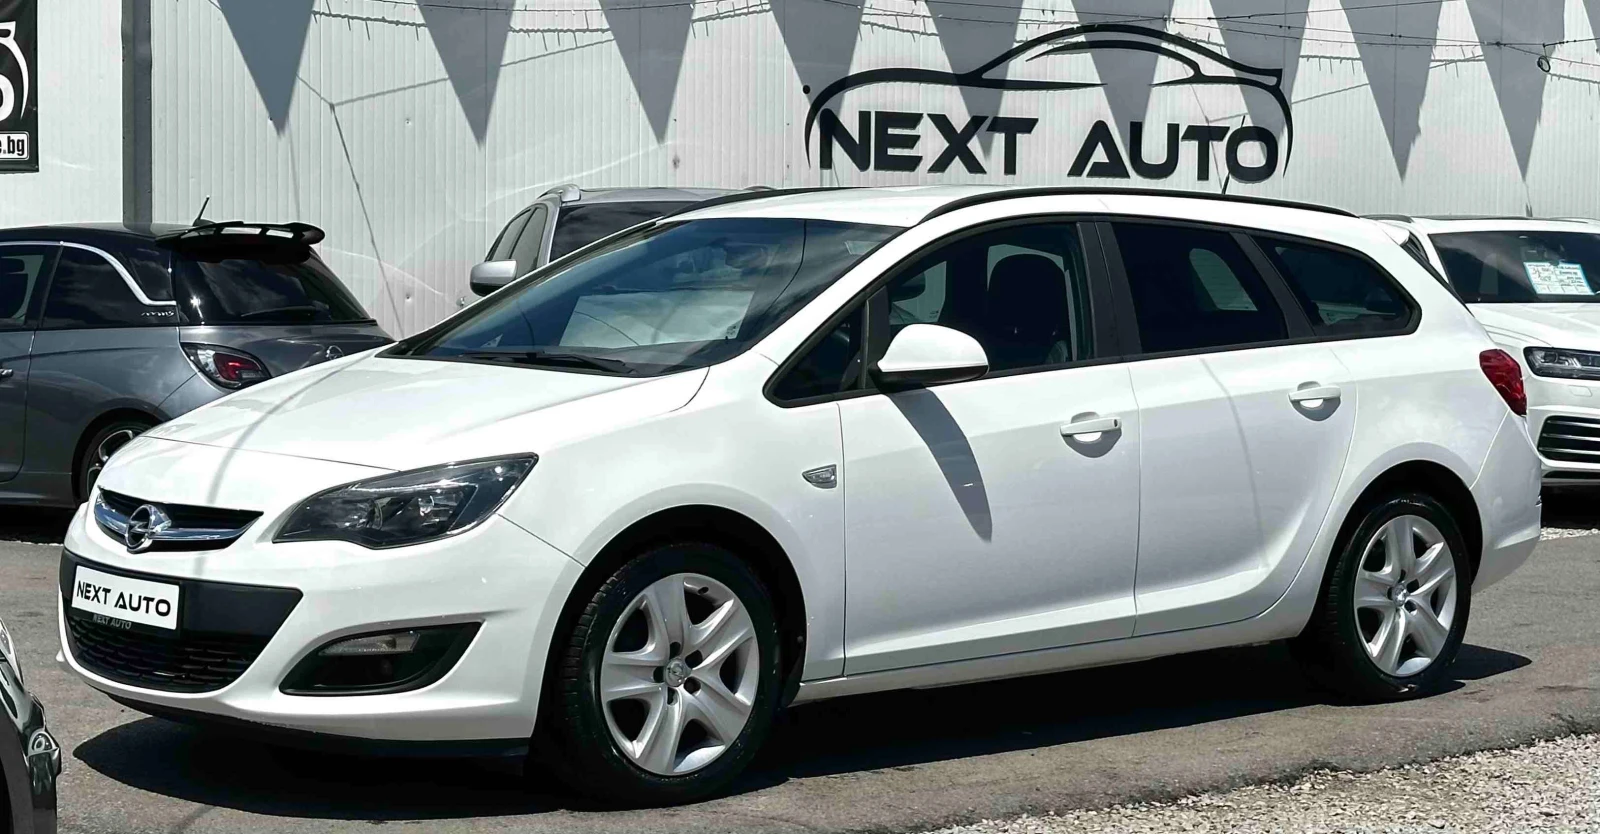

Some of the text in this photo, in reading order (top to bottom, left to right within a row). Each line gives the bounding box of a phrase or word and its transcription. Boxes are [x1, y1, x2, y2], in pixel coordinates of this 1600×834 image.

[0, 135, 25, 156] .bg
[819, 108, 1279, 183] NEXT AUTO
[76, 580, 171, 617] NEXT AUTO
[93, 614, 132, 630] NEXT AUTO
